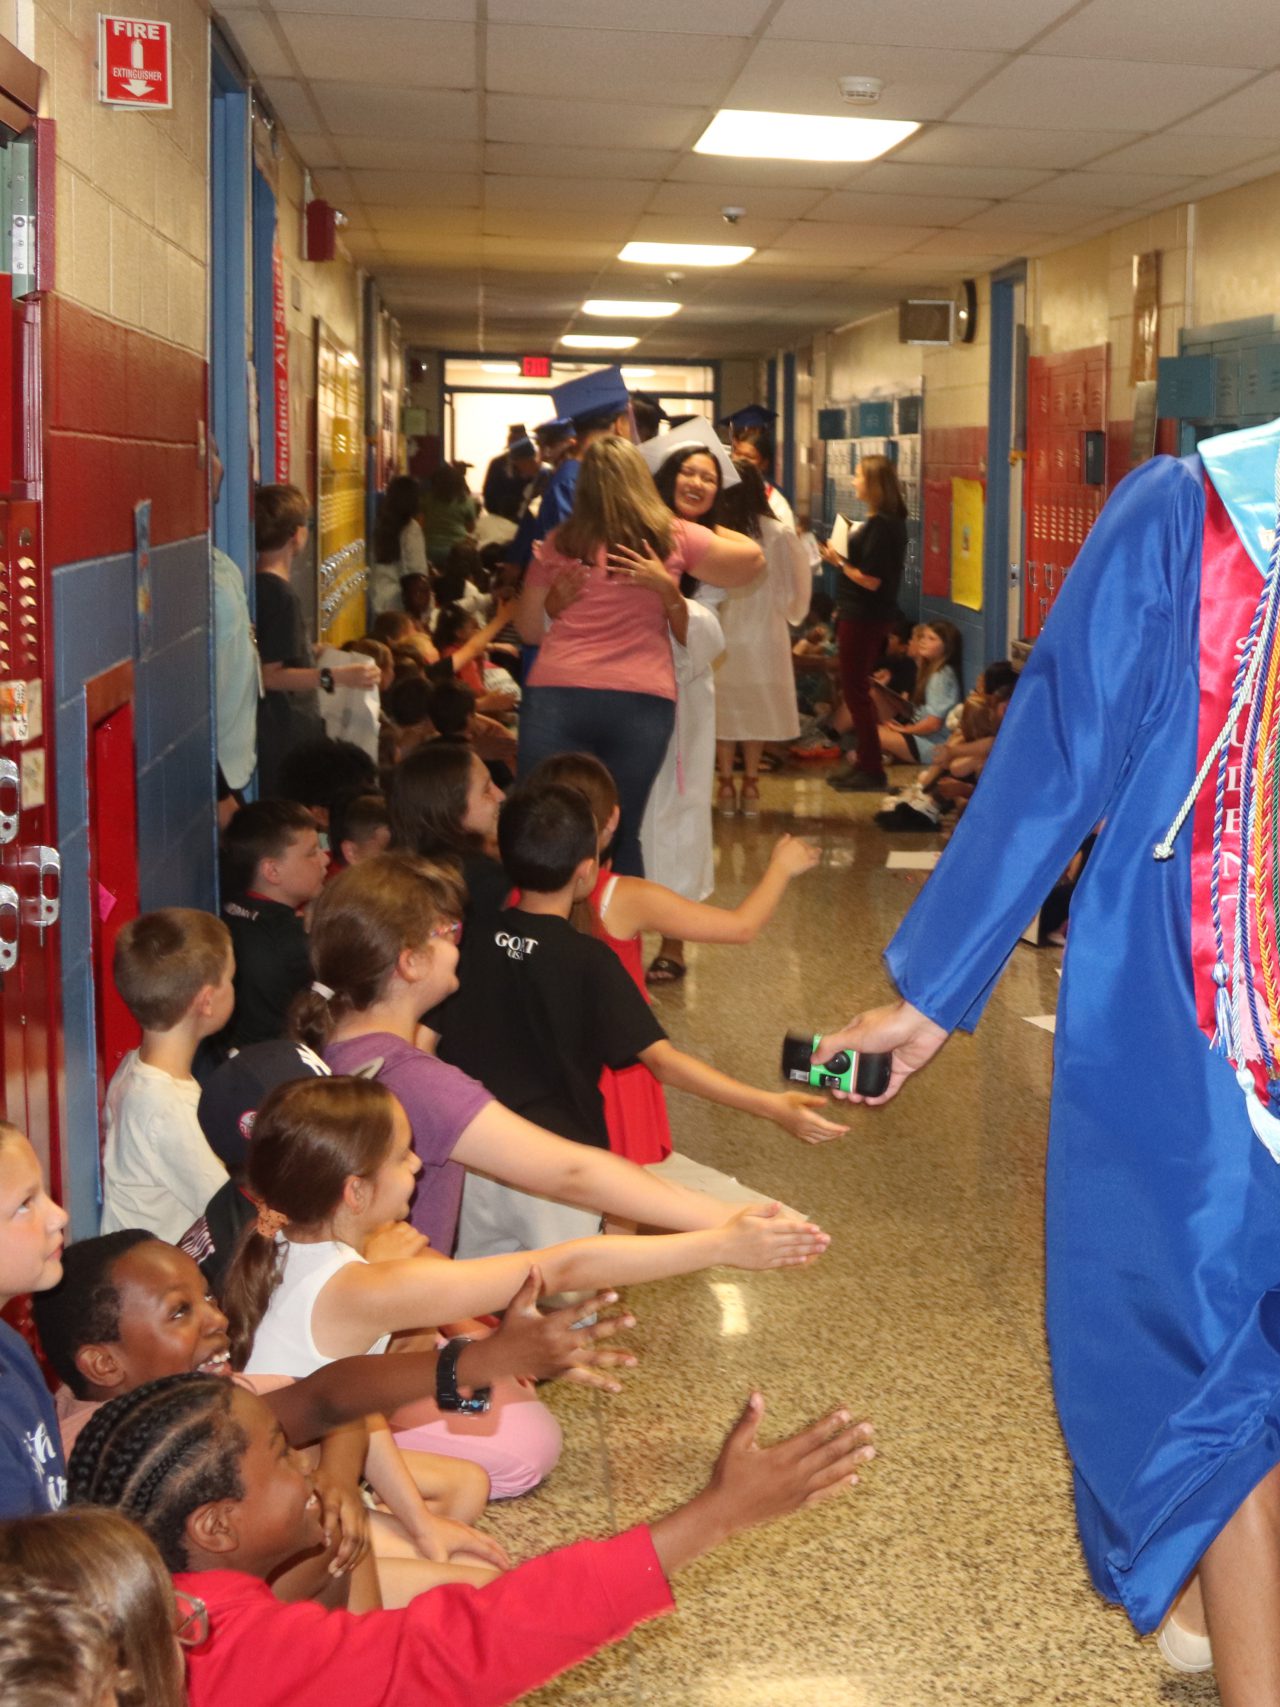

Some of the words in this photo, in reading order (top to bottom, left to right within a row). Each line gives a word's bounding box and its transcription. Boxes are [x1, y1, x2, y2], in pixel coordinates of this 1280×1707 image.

[113, 20, 160, 40] FIRE
[112, 67, 162, 81] EXTINGUISHER
[278, 378, 288, 481] tendance
